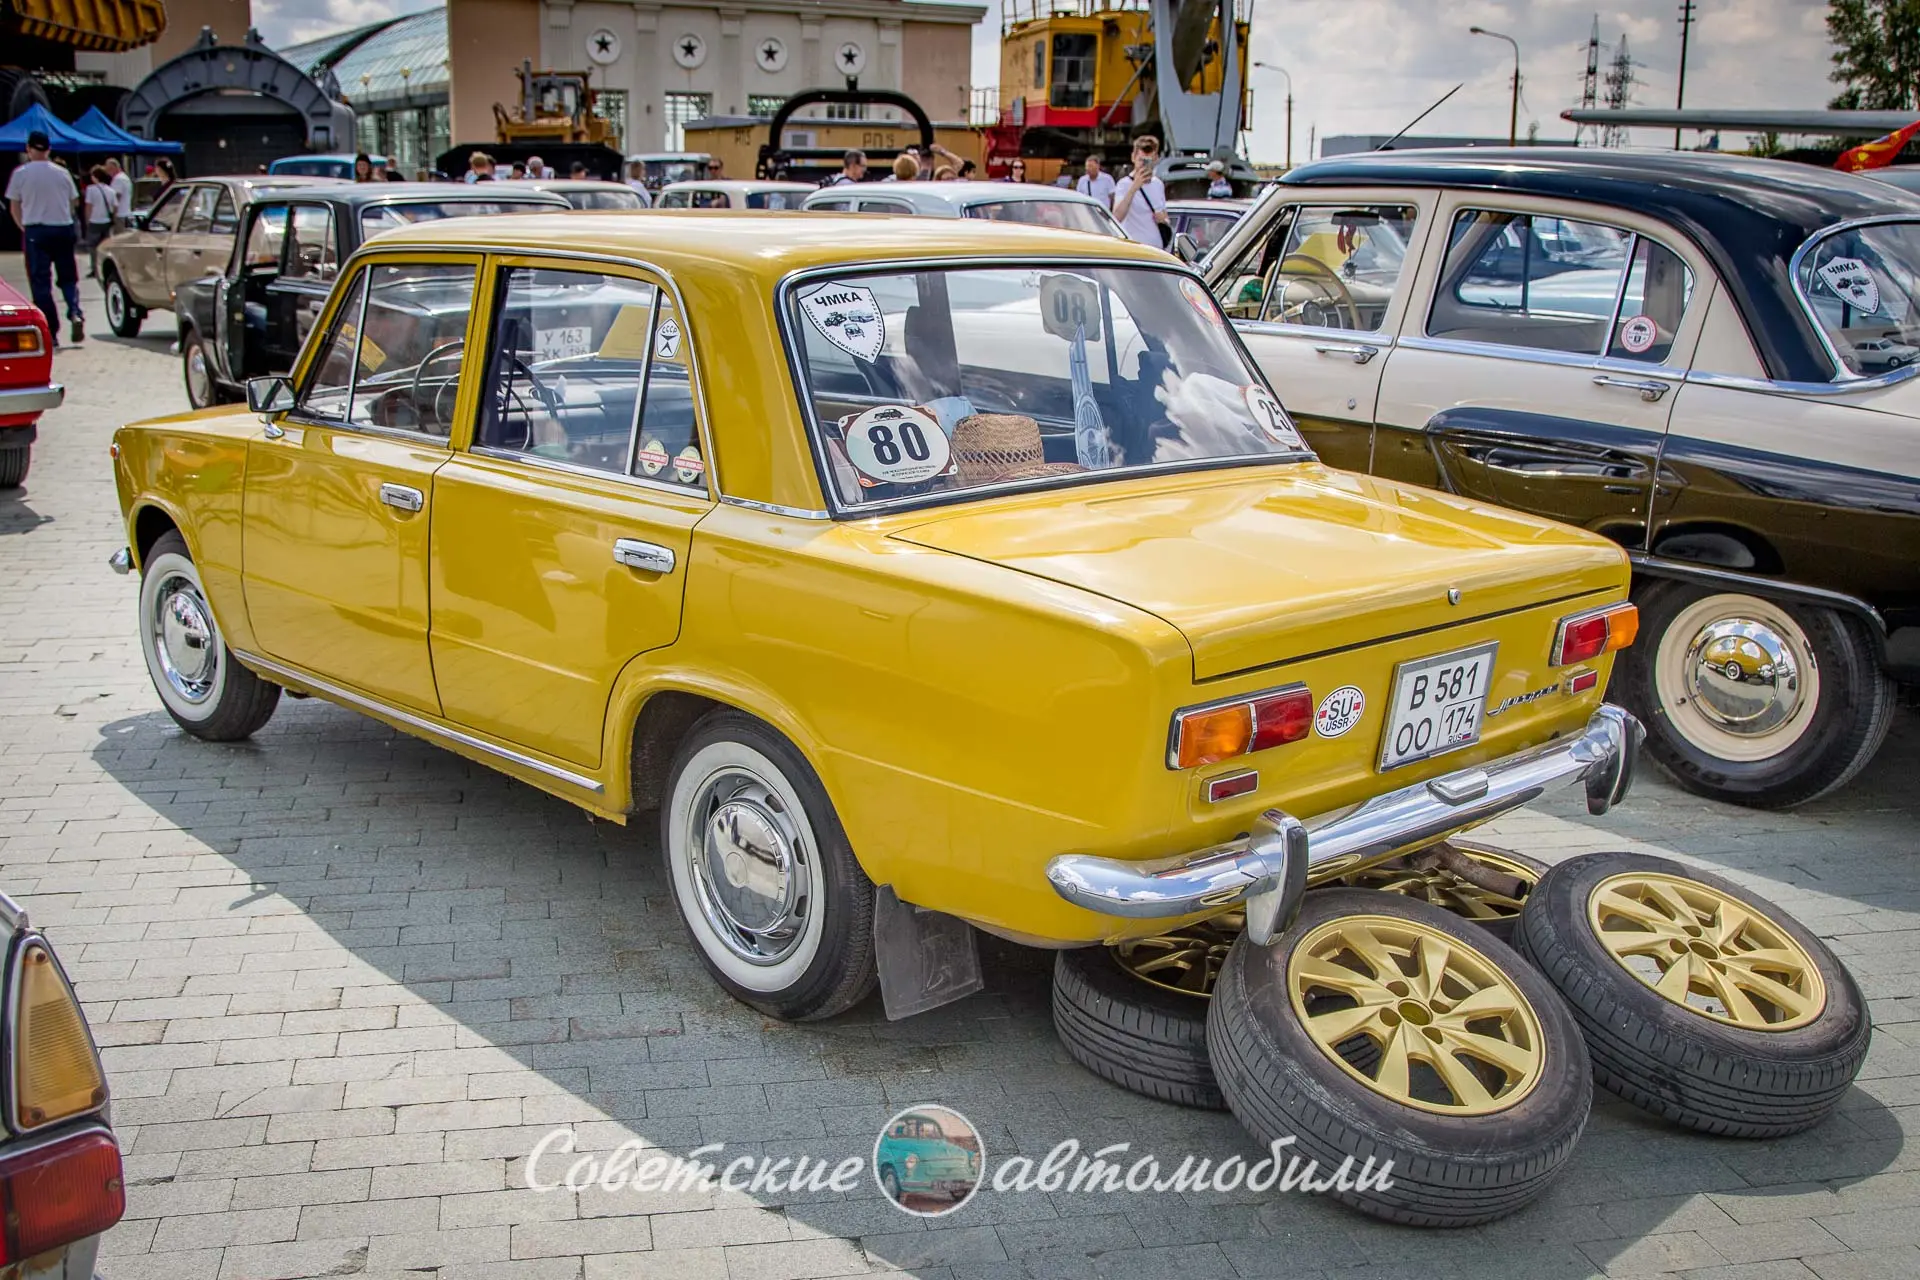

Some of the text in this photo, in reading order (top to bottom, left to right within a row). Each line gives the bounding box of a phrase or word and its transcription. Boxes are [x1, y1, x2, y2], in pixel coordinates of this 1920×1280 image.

[1827, 262, 1860, 275] ЧМКА
[814, 291, 863, 306] ЧМКА
[559, 329, 583, 346] 163
[1258, 399, 1292, 432] 25
[867, 422, 931, 466] 80
[1409, 661, 1480, 711] В 581
[1328, 696, 1354, 721] SU
[1325, 717, 1350, 732] USSR
[1445, 704, 1476, 735] 174
[1447, 733, 1462, 745] RUS
